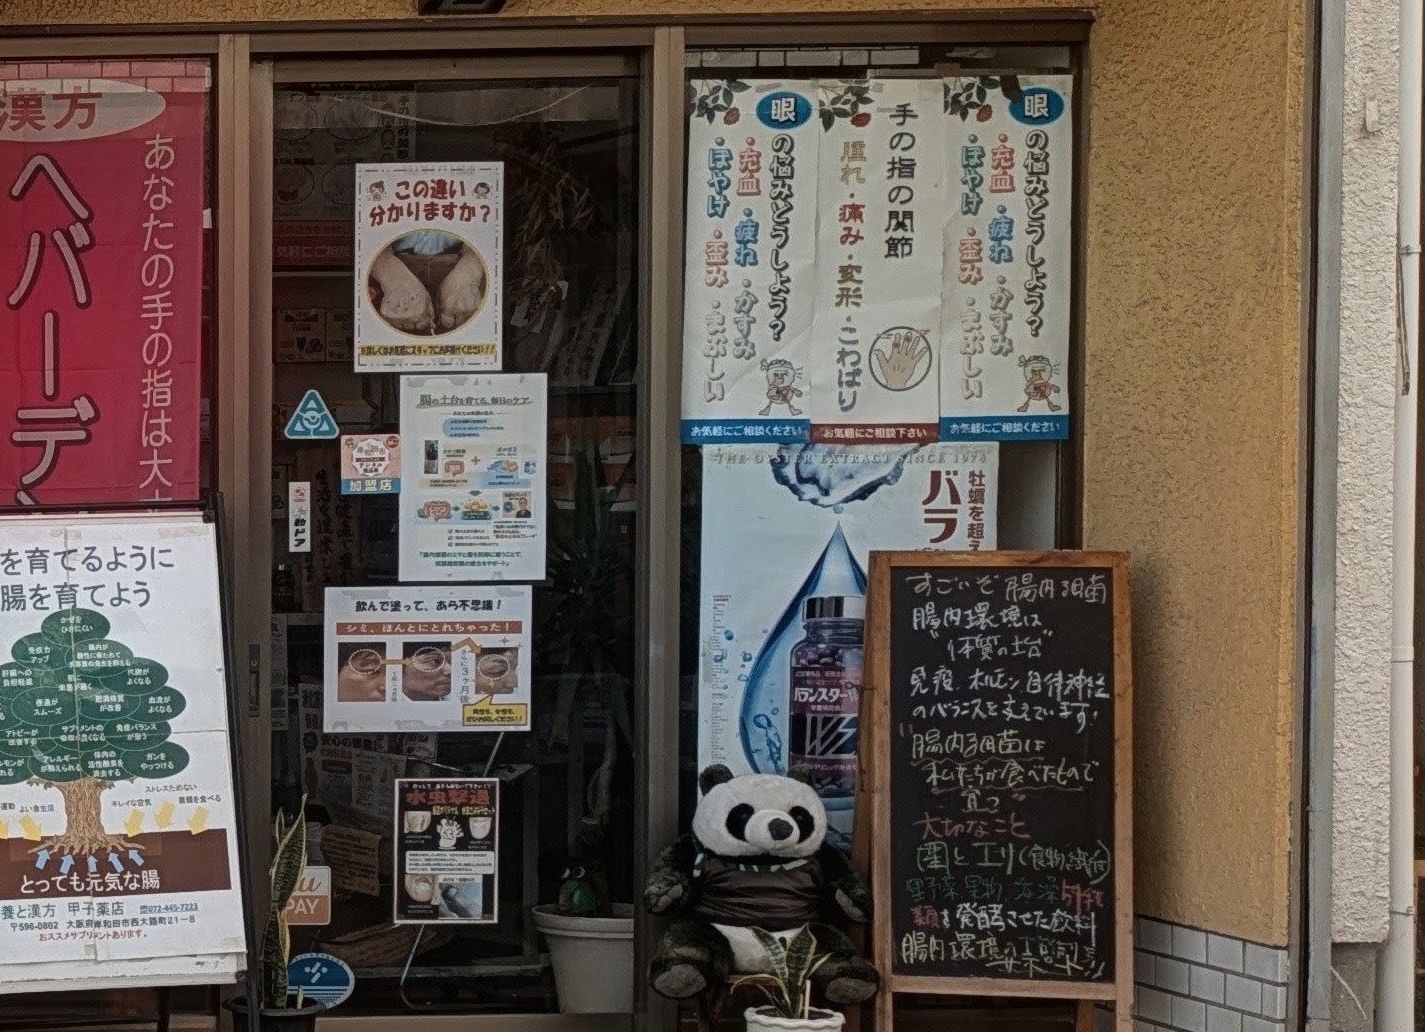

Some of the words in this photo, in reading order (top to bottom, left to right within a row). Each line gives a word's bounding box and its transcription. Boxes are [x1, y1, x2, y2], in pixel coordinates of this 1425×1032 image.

[394, 178, 467, 200] この違い
[883, 102, 919, 259] 手の指の関節
[6, 152, 100, 506] ヘバーデ
[921, 469, 962, 552] バラ
[0, 581, 153, 612] 腸を育てよう
[20, 869, 161, 896] とっても元気な腸
[68, 901, 125, 917] 甲子薬店
